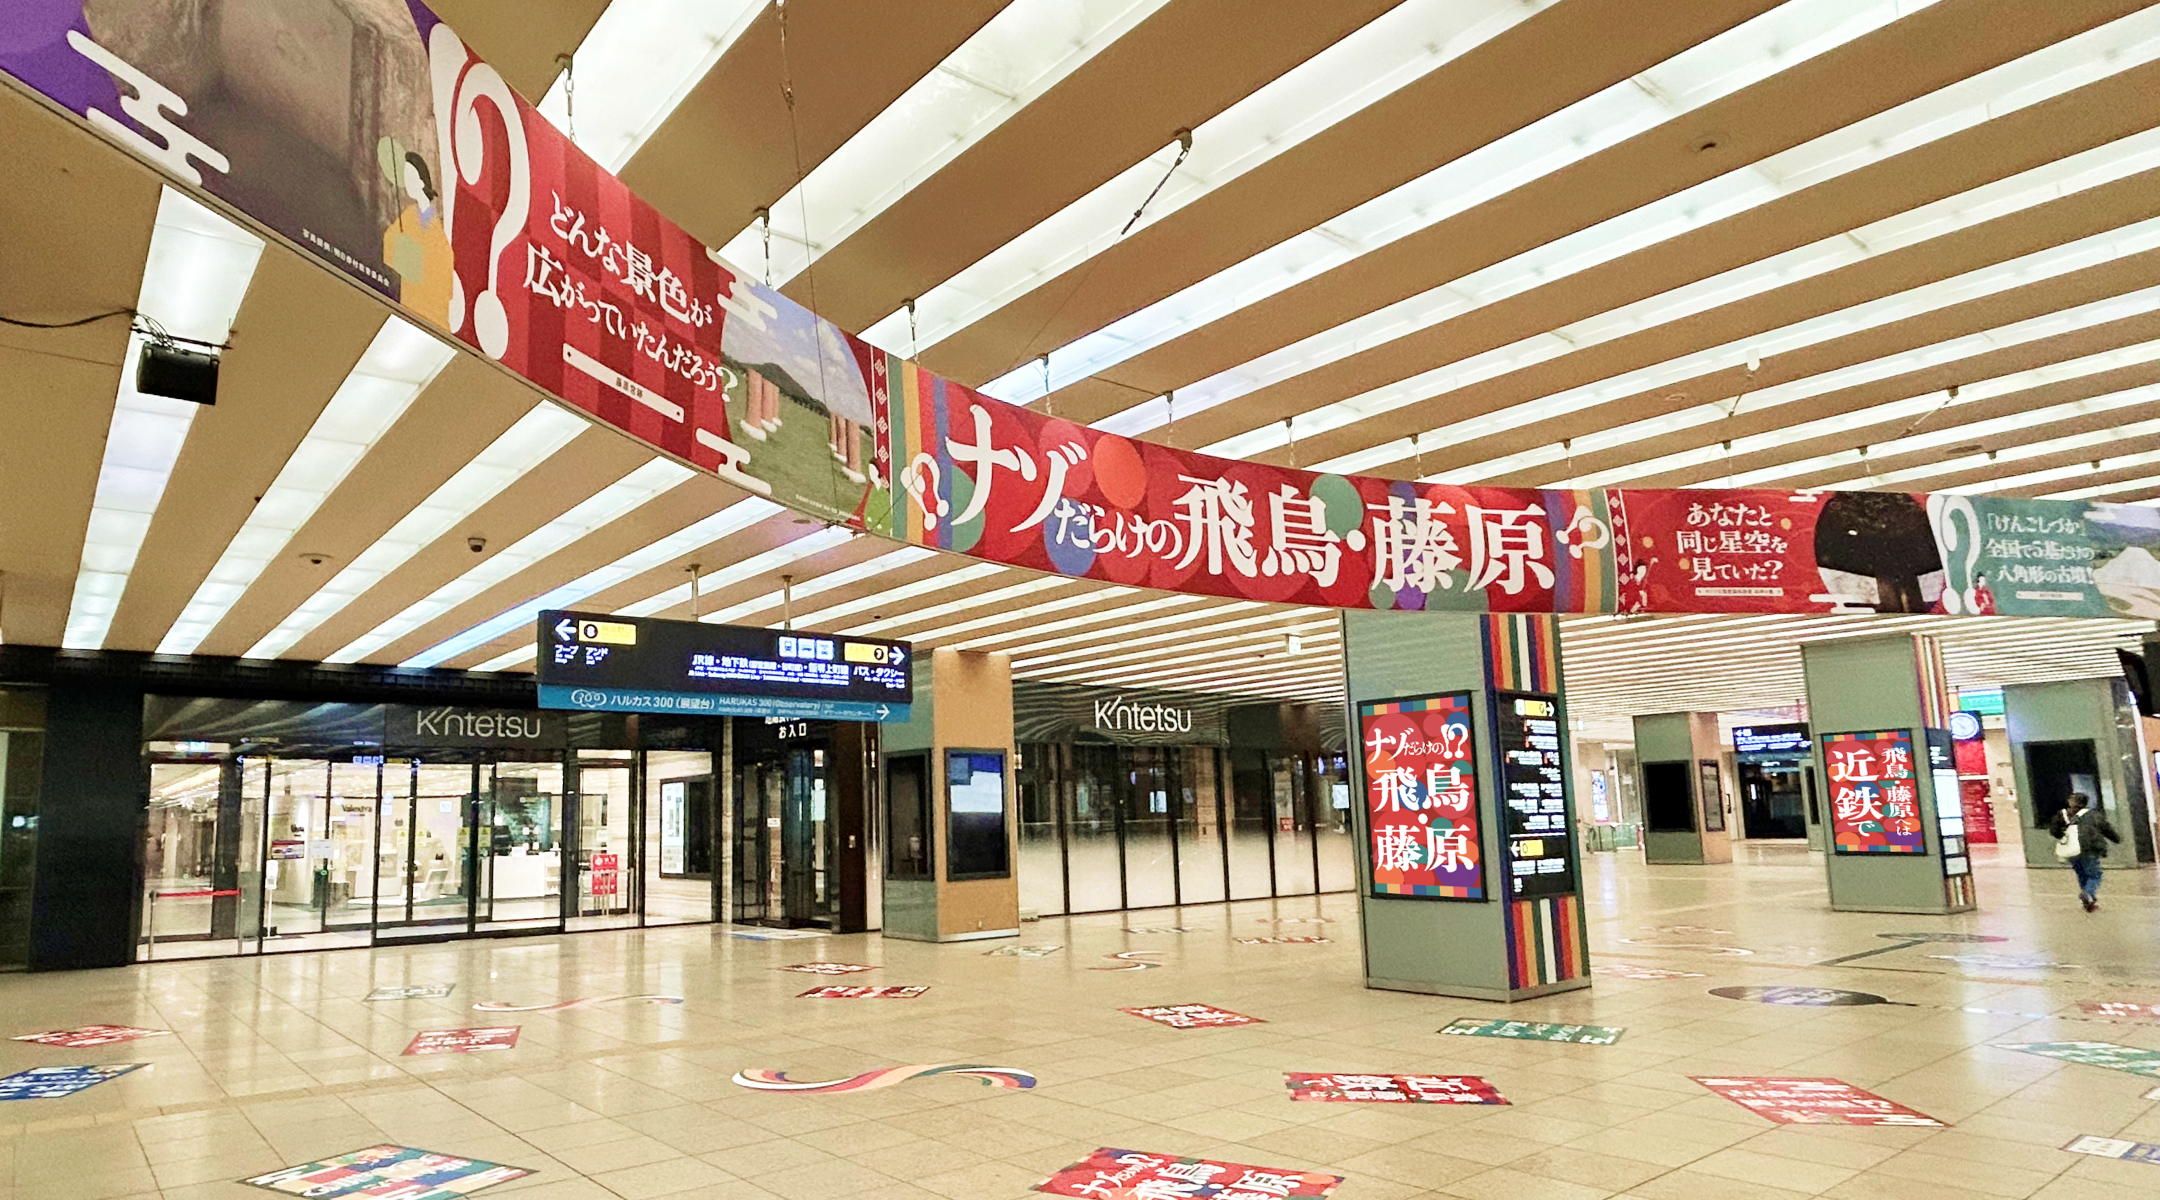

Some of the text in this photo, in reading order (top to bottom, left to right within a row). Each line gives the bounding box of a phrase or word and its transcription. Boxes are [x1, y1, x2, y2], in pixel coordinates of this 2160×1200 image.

[551, 189, 713, 328] どんな景色が
[523, 242, 739, 403] 広がっていたんだろう?
[1687, 502, 1773, 527] あなたと
[1676, 530, 1788, 554] 同じ星空を
[1689, 557, 1783, 581] 見ていた?
[853, 666, 905, 677] バス・タクシー
[719, 697, 757, 707] HARUKAS
[1831, 748, 1885, 837] 近鉄で
[1881, 746, 1915, 837] 飛鳥・藤原へは
[1374, 824, 1475, 873] 藤原
